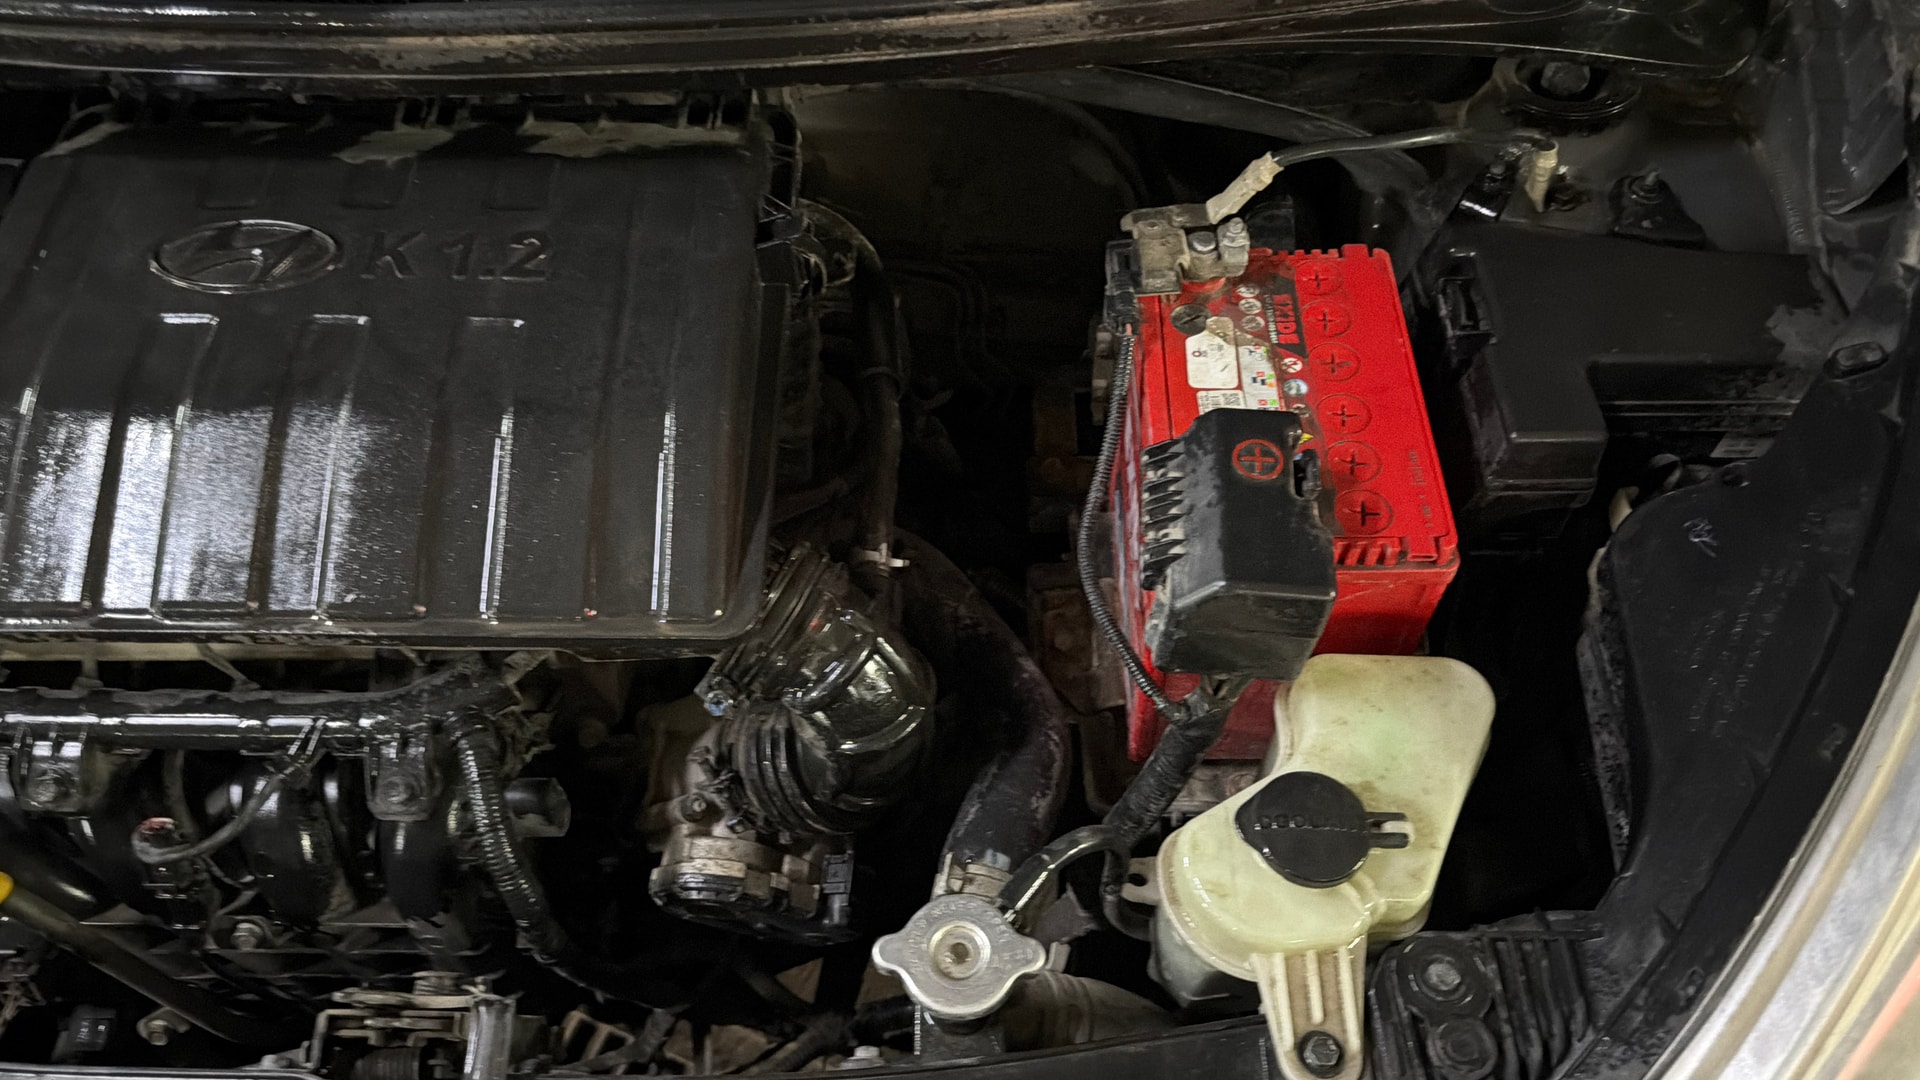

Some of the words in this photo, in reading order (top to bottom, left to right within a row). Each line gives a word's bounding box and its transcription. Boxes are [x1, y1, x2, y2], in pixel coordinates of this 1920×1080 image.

[361, 231, 427, 279] K
[443, 230, 549, 281] 1.2
[1273, 294, 1300, 344] EXIDE
